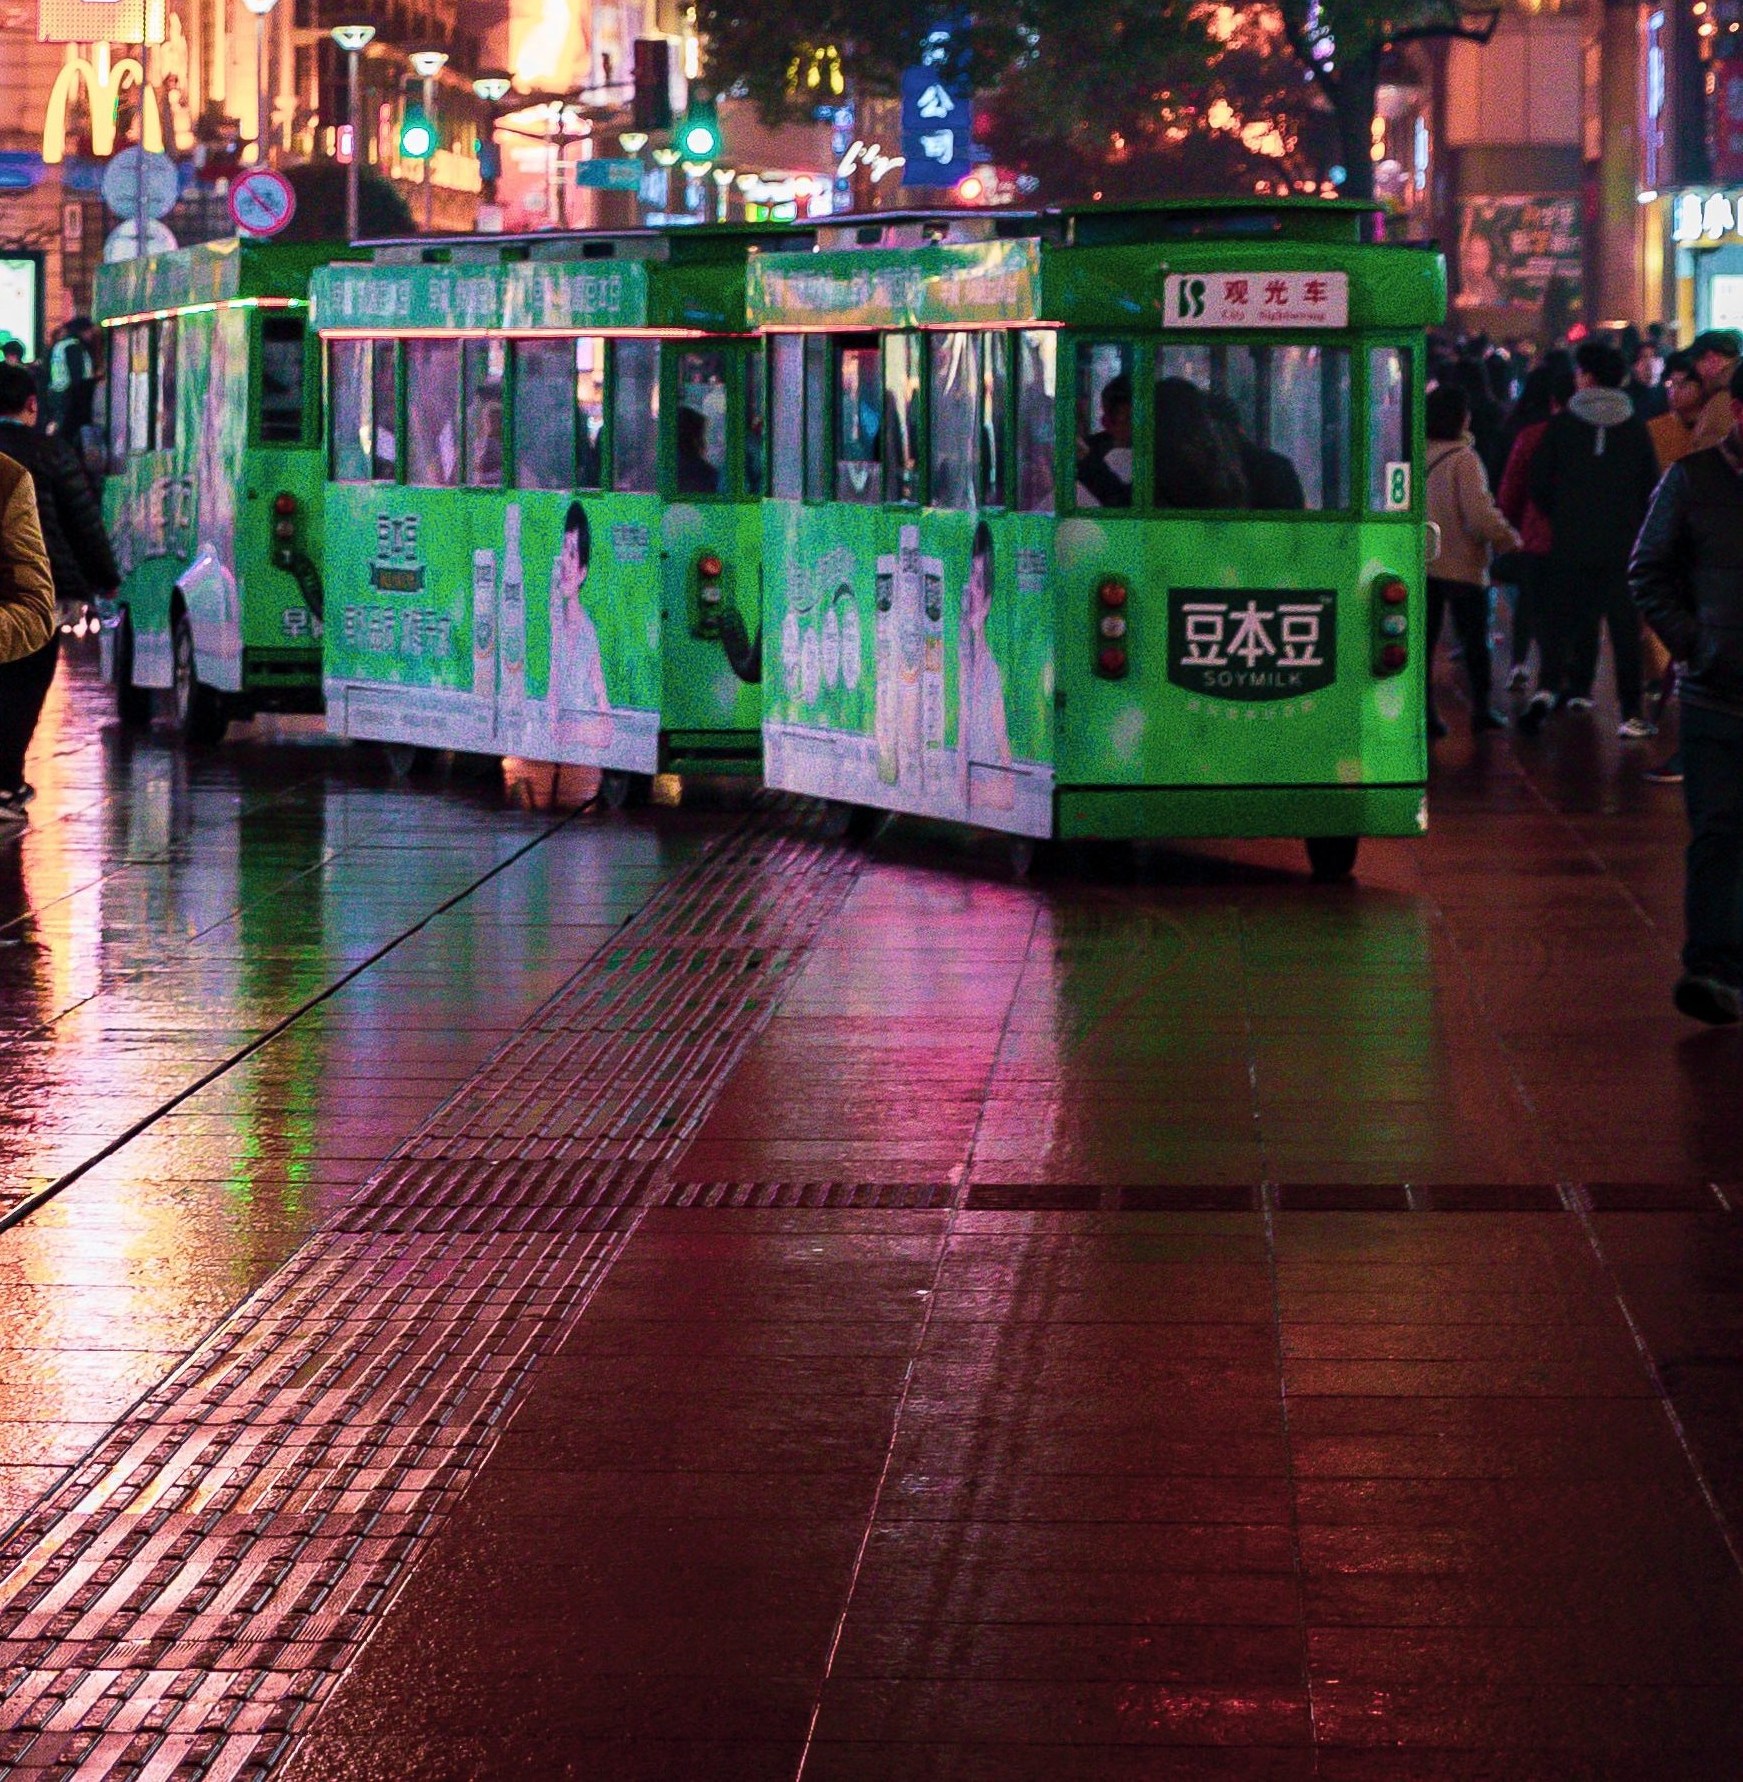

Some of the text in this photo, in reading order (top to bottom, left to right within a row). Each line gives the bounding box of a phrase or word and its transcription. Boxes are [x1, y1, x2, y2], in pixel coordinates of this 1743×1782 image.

[1224, 279, 1328, 305] 观光车
[1180, 599, 1324, 668] 豆本豆
[1204, 670, 1303, 688] SOYMILK
